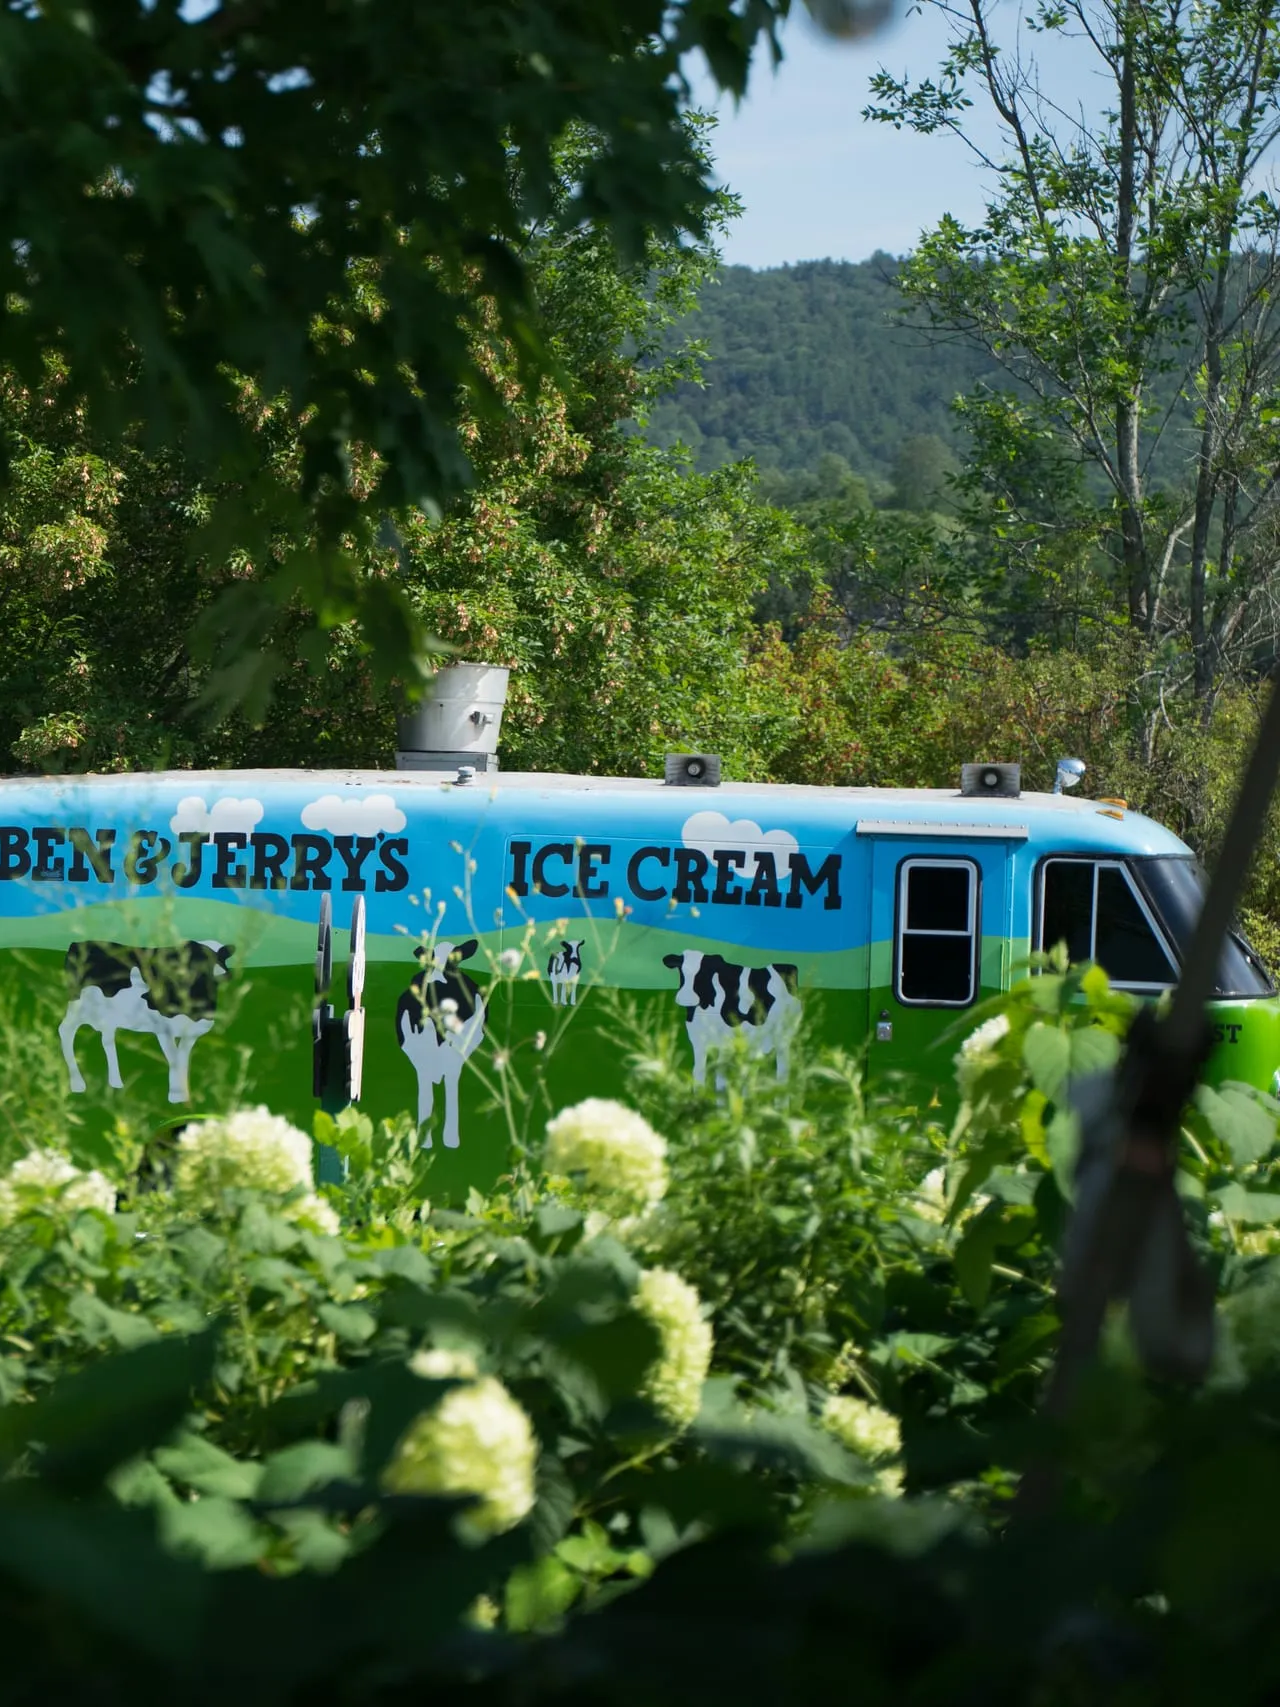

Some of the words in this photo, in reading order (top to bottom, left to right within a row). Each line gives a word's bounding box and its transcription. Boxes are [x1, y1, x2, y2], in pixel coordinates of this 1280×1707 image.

[171, 831, 410, 893] JERRY'S
[509, 841, 611, 898] ICE
[627, 846, 842, 911] CREAM
